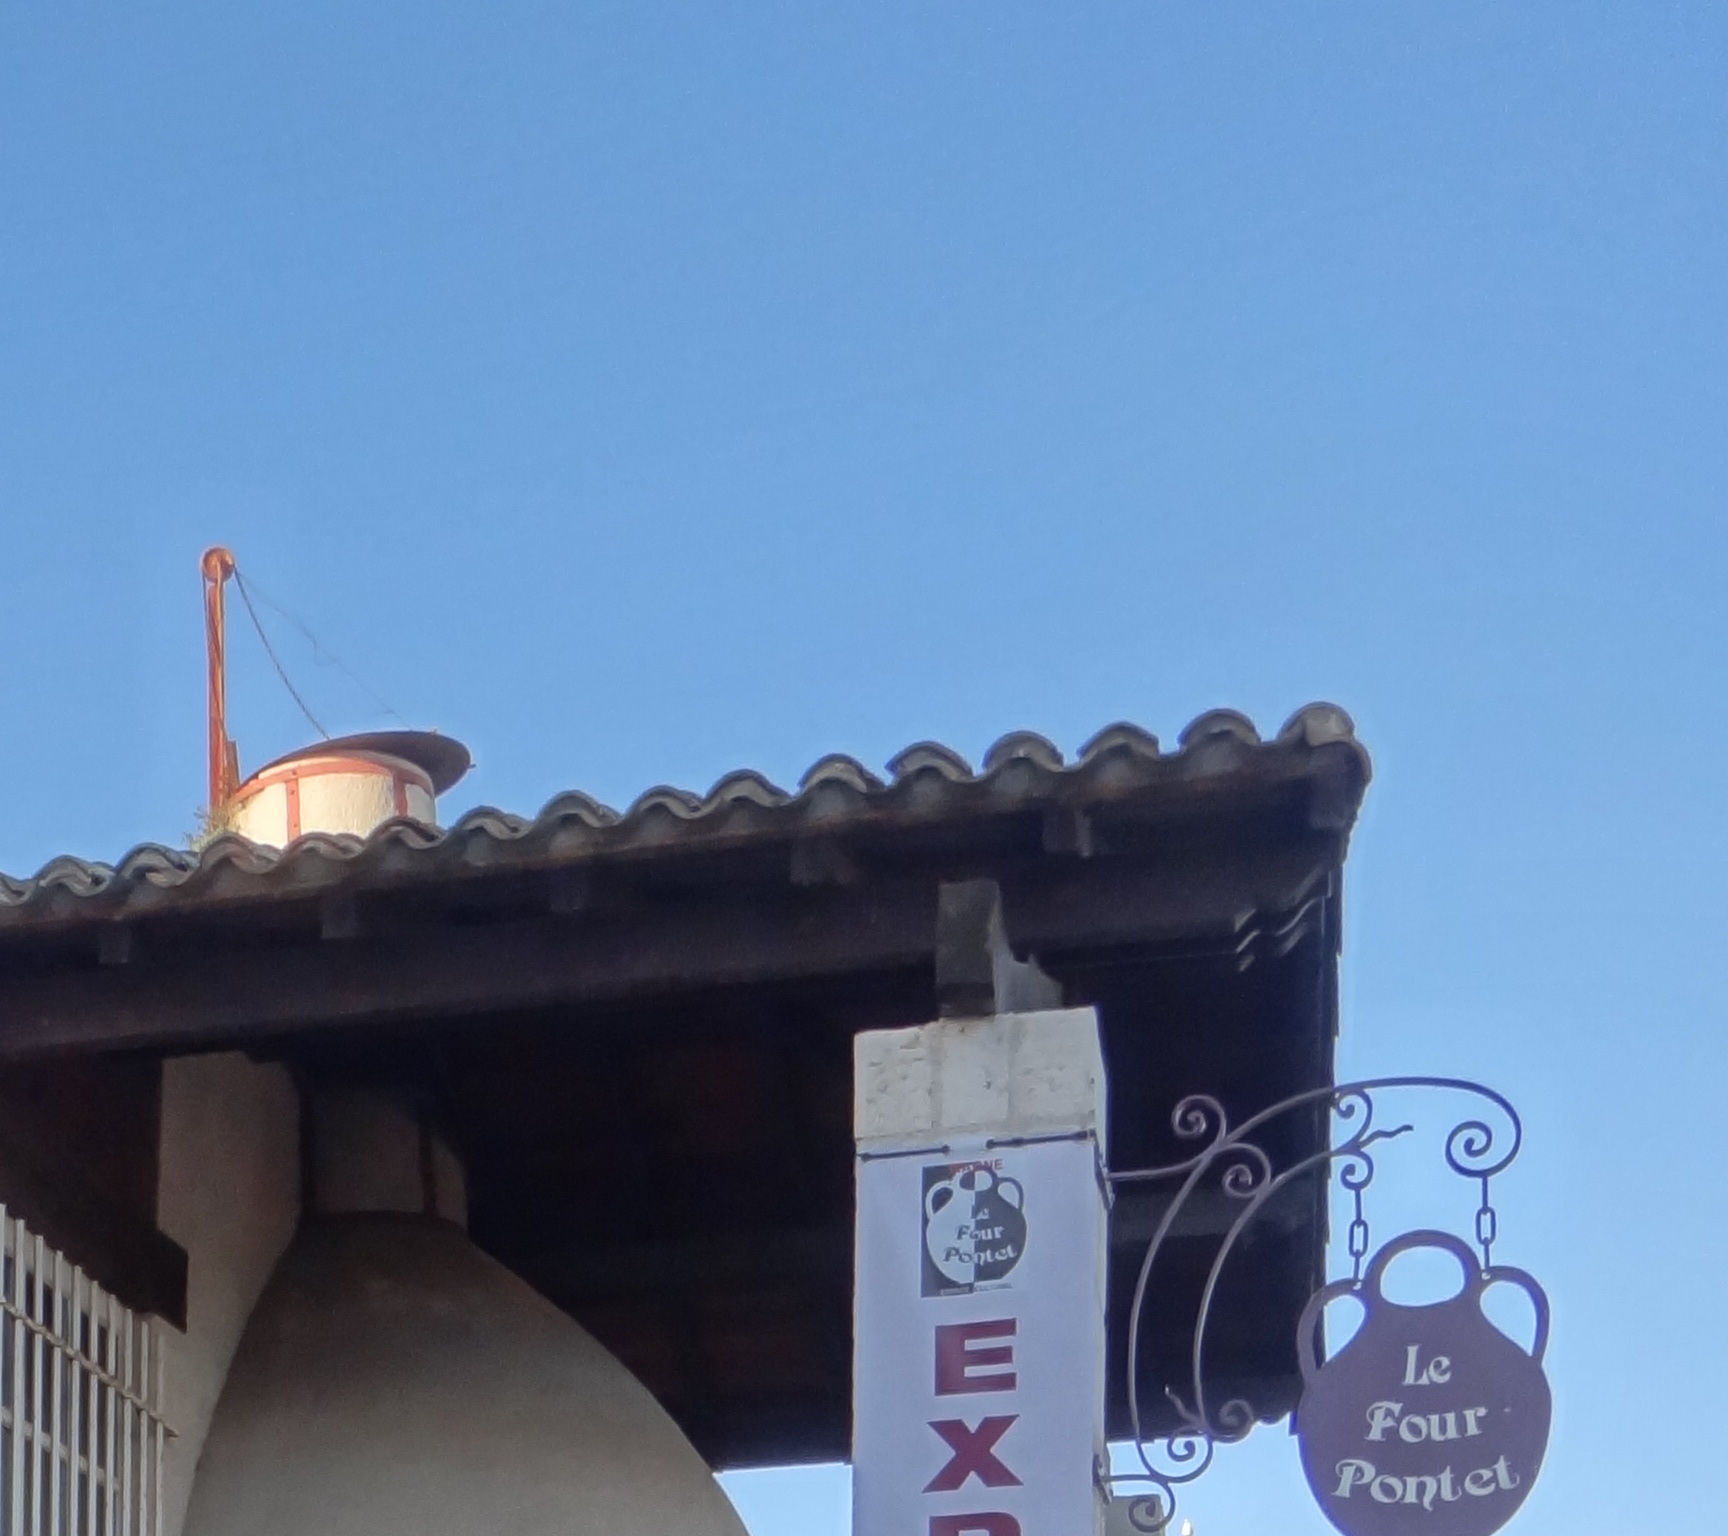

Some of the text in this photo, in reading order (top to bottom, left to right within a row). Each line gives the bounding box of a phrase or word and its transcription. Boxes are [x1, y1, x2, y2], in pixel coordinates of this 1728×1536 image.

[955, 1224, 1005, 1241] Four
[942, 1244, 1018, 1266] Pontet
[1401, 1344, 1452, 1387] Le
[1363, 1401, 1489, 1443] Four
[1330, 1454, 1521, 1513] Pontet
